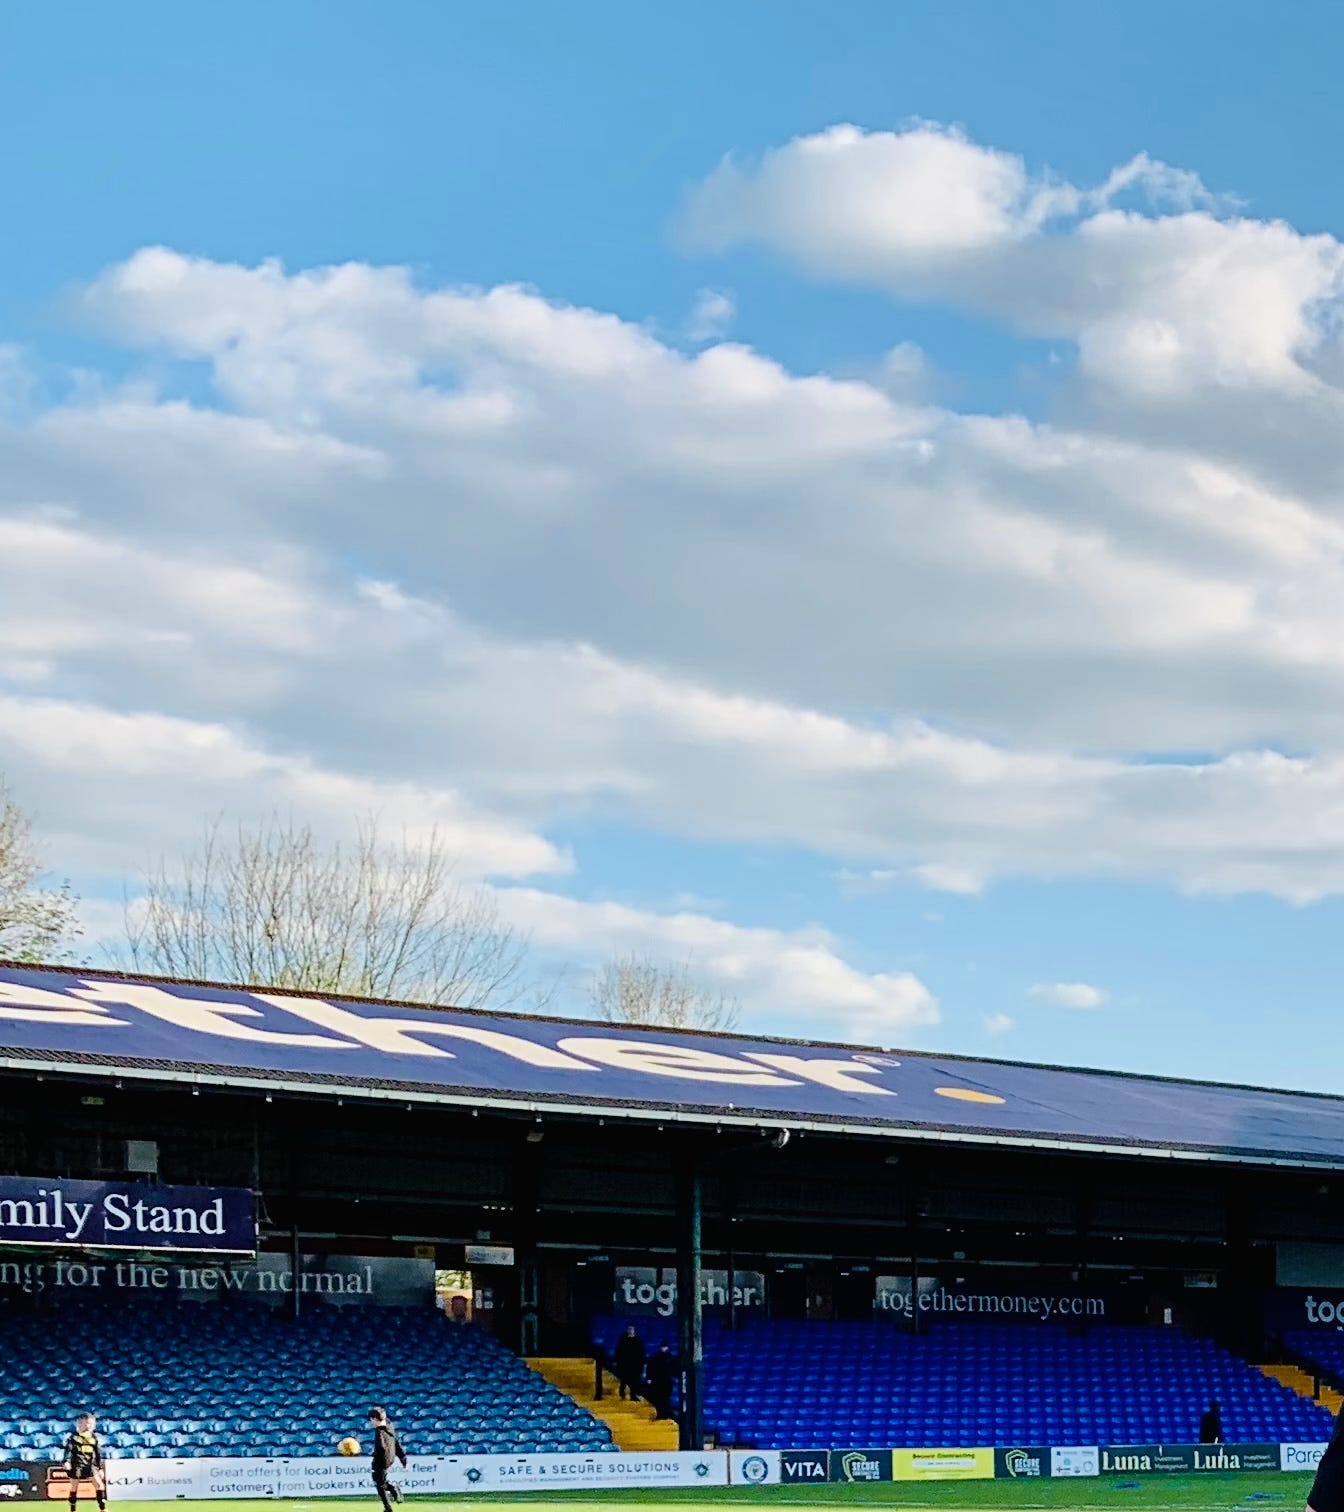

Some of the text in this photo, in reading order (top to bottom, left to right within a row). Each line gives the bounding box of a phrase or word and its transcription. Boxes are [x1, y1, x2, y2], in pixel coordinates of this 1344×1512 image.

[0, 1189, 226, 1239] mily Stand
[49, 1260, 106, 1287] for
[117, 1262, 168, 1289] the
[178, 1266, 249, 1291] new
[257, 1264, 374, 1295] normal
[622, 1278, 761, 1317] togher.
[882, 1286, 1105, 1320] togethermoney.com
[1102, 1451, 1152, 1471] Luna
[1287, 1446, 1323, 1464] Pare
[210, 1467, 244, 1478] Great
[247, 1466, 281, 1478] offers
[285, 1465, 301, 1477] for
[304, 1464, 332, 1476] local
[335, 1463, 372, 1475] busine
[412, 1463, 437, 1473] fleet
[499, 1462, 680, 1476] SAFE & SECURE SOLUTIONS
[785, 1462, 825, 1477] VITA
[147, 1476, 193, 1487] Business
[209, 1481, 273, 1493] customers
[277, 1480, 305, 1491] from
[308, 1479, 355, 1490] Lookers
